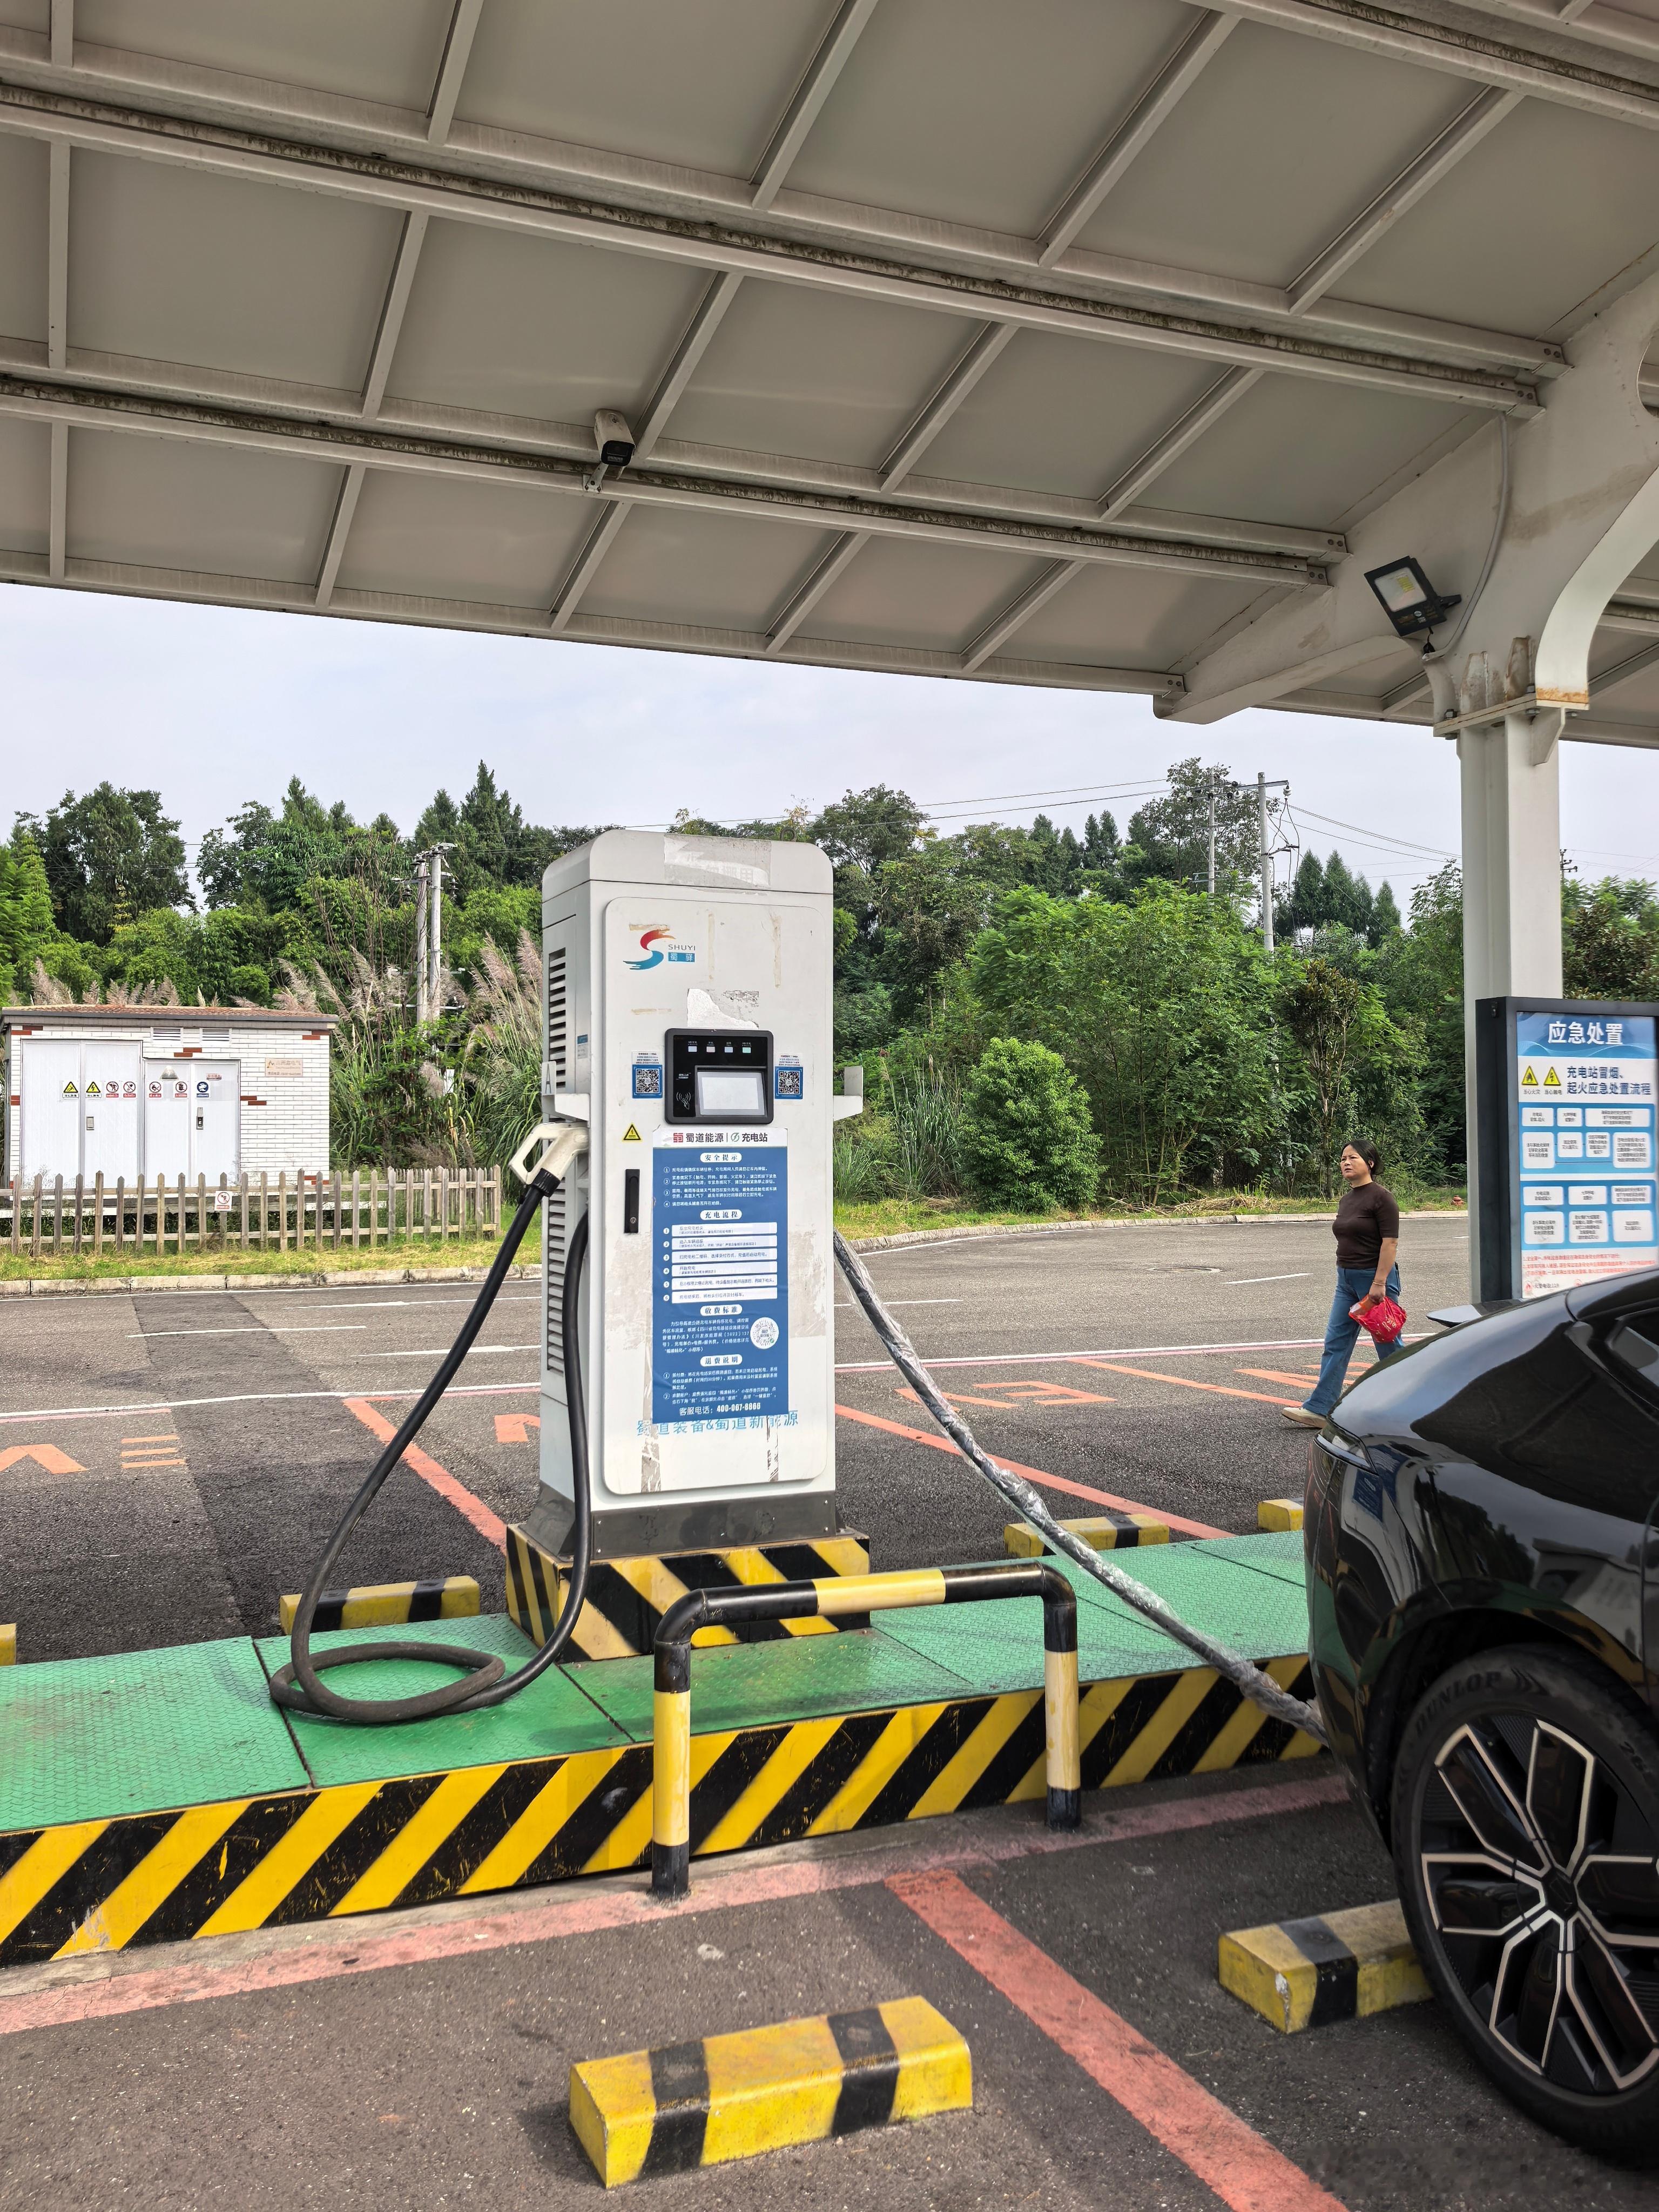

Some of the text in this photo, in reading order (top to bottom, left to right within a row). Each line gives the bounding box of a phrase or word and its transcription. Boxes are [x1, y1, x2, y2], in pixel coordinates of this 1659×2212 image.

[1548, 1021, 1623, 1045] 应急处置
[1567, 1066, 1623, 1078] 充电站冒烟、
[1567, 1082, 1652, 1095] 起火应急处置流程
[686, 1132, 768, 1143] 蜀道能源 充电站
[705, 1211, 738, 1219] 充电流程
[705, 1356, 738, 1365] 退费说明
[1416, 1671, 1501, 1738] DUNLOP
